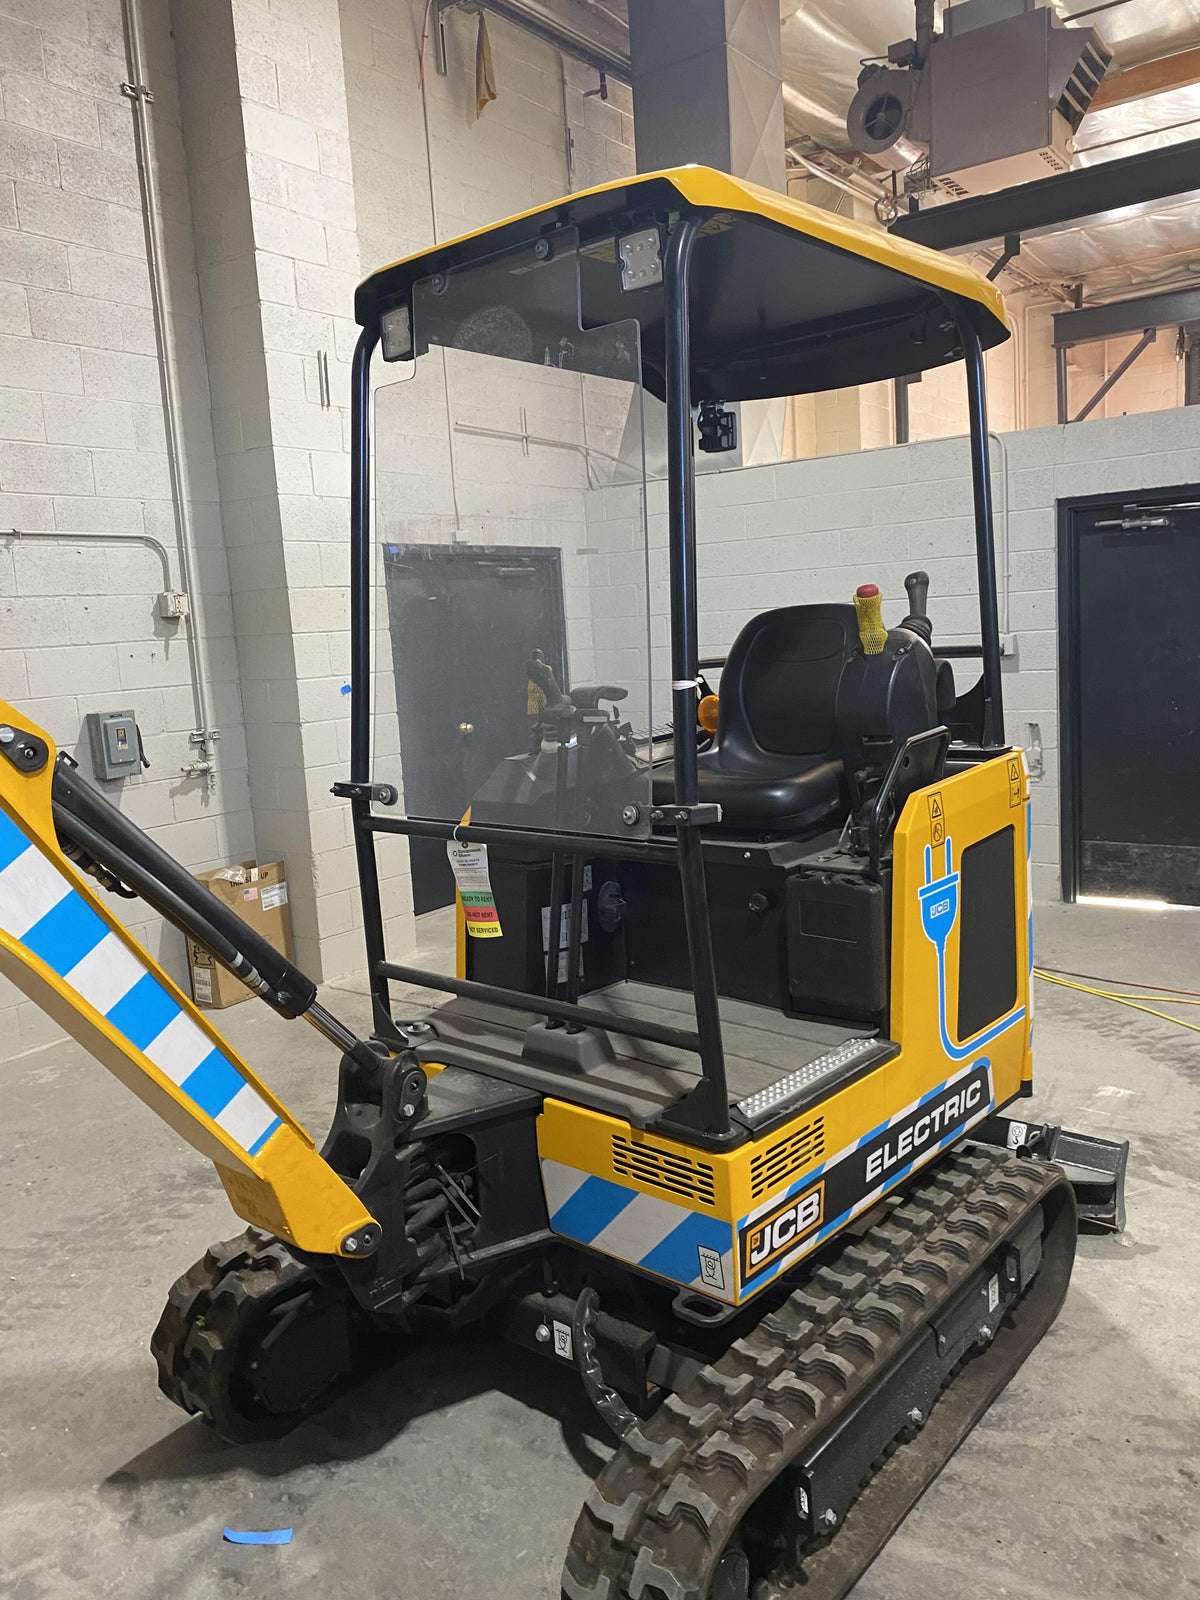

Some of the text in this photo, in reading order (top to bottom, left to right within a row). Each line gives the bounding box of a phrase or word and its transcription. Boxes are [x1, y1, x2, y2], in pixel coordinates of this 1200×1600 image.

[260, 871, 269, 879] UP
[931, 900, 949, 917] JCB
[865, 1079, 982, 1183] ELECTRIC
[750, 1192, 820, 1265] JCB
